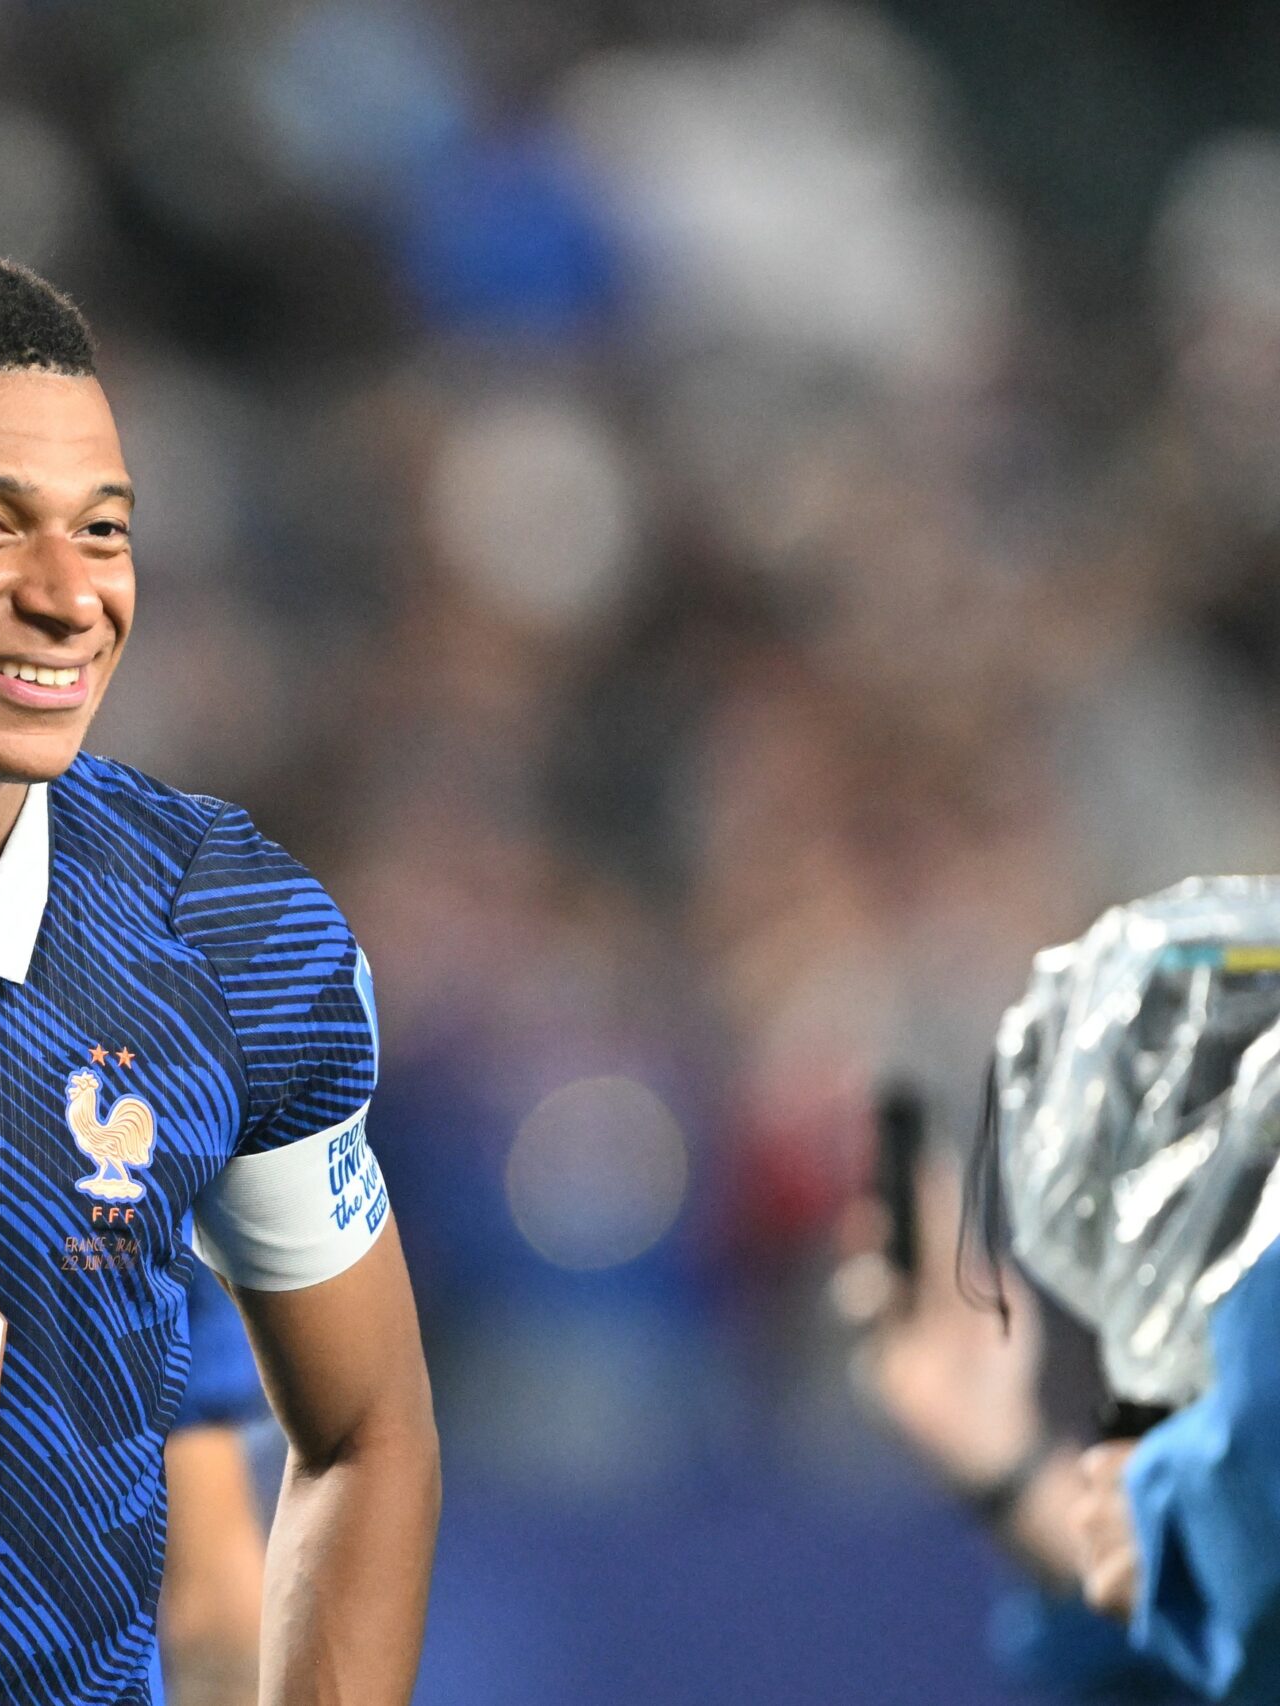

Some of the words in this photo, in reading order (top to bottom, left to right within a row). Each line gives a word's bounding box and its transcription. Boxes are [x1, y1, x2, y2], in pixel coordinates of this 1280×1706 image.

[330, 1194, 362, 1230] the
[64, 1236, 107, 1253] FRANCE
[116, 1237, 141, 1254] IRAK
[61, 1255, 79, 1271] 22
